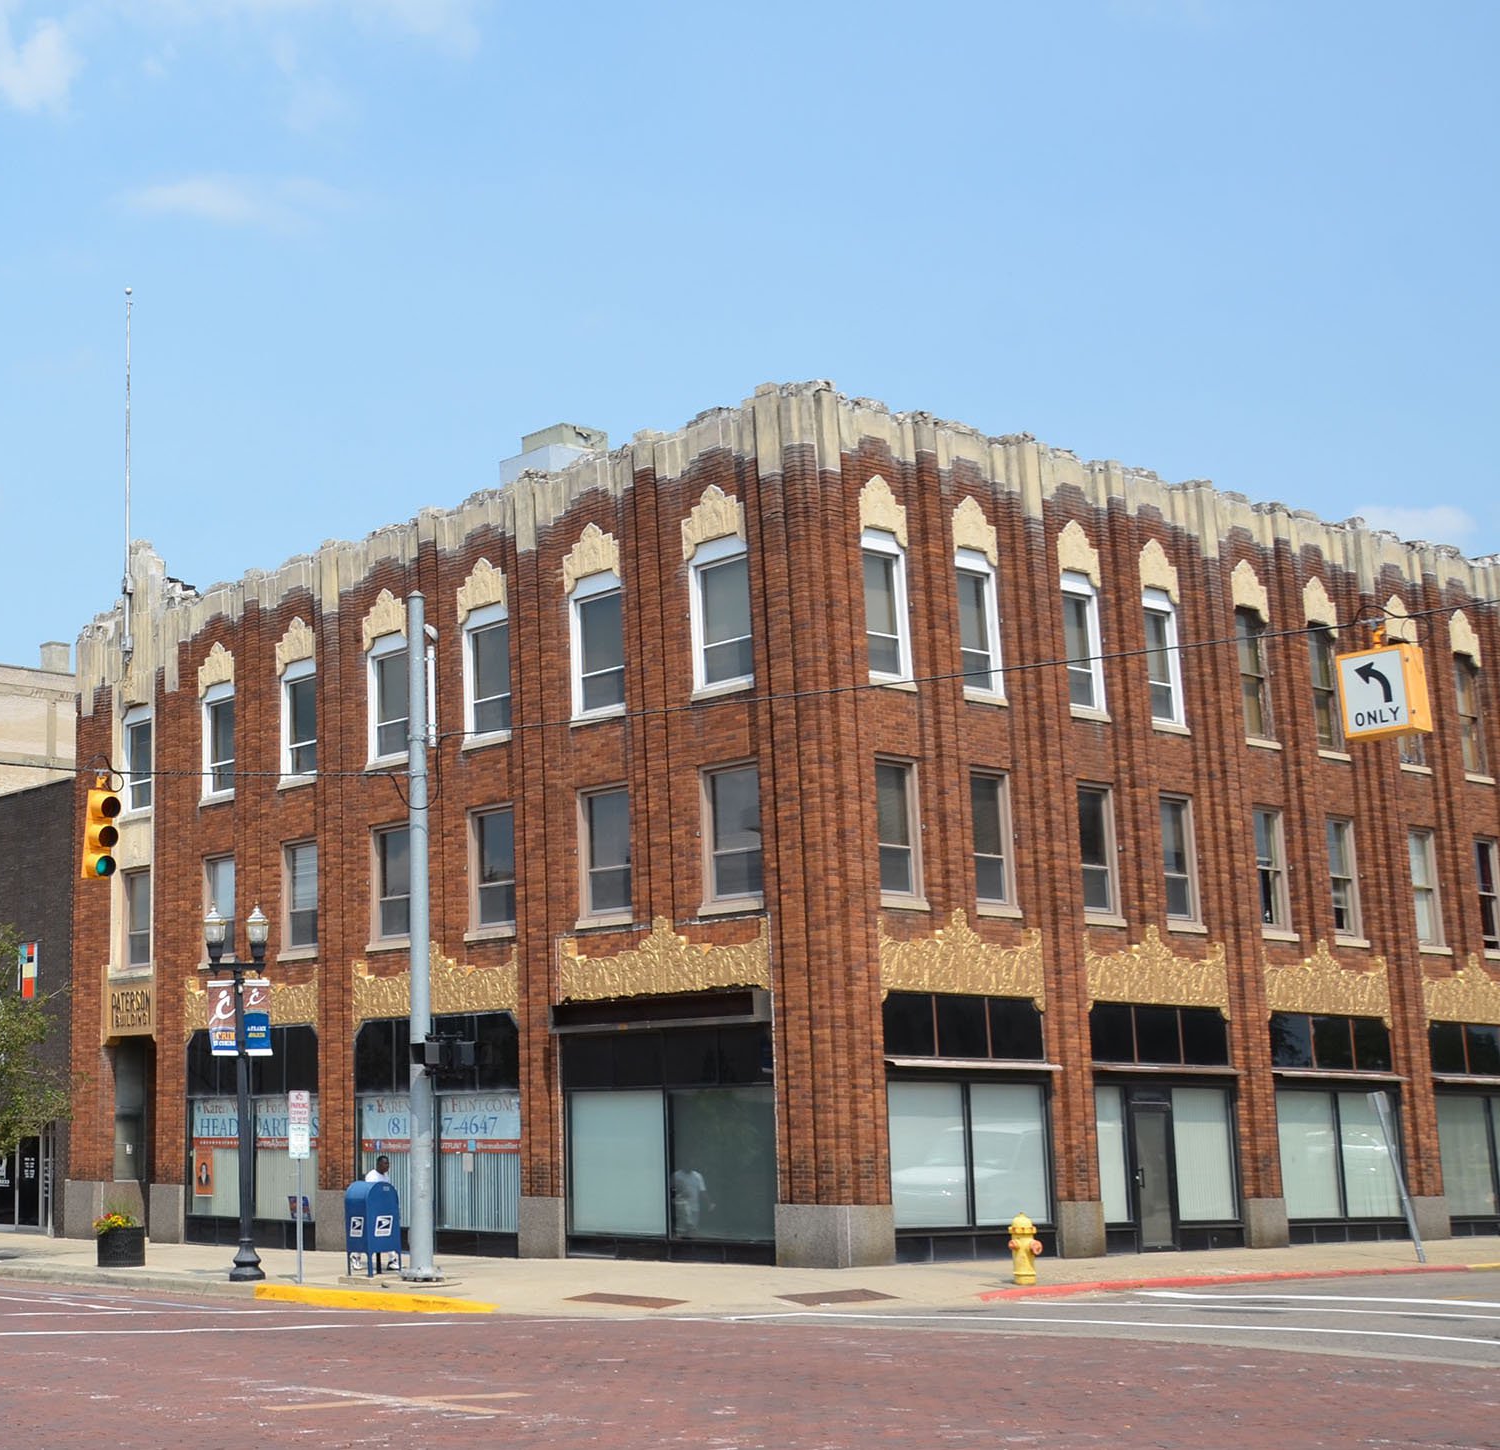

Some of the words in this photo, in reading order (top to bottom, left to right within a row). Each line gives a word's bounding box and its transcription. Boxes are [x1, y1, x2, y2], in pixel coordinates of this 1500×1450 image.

[1355, 706, 1400, 726] ONLY
[112, 990, 150, 1012] PATERSON
[115, 1011, 148, 1028] BUILDING
[443, 1115, 498, 1135] 7-4647
